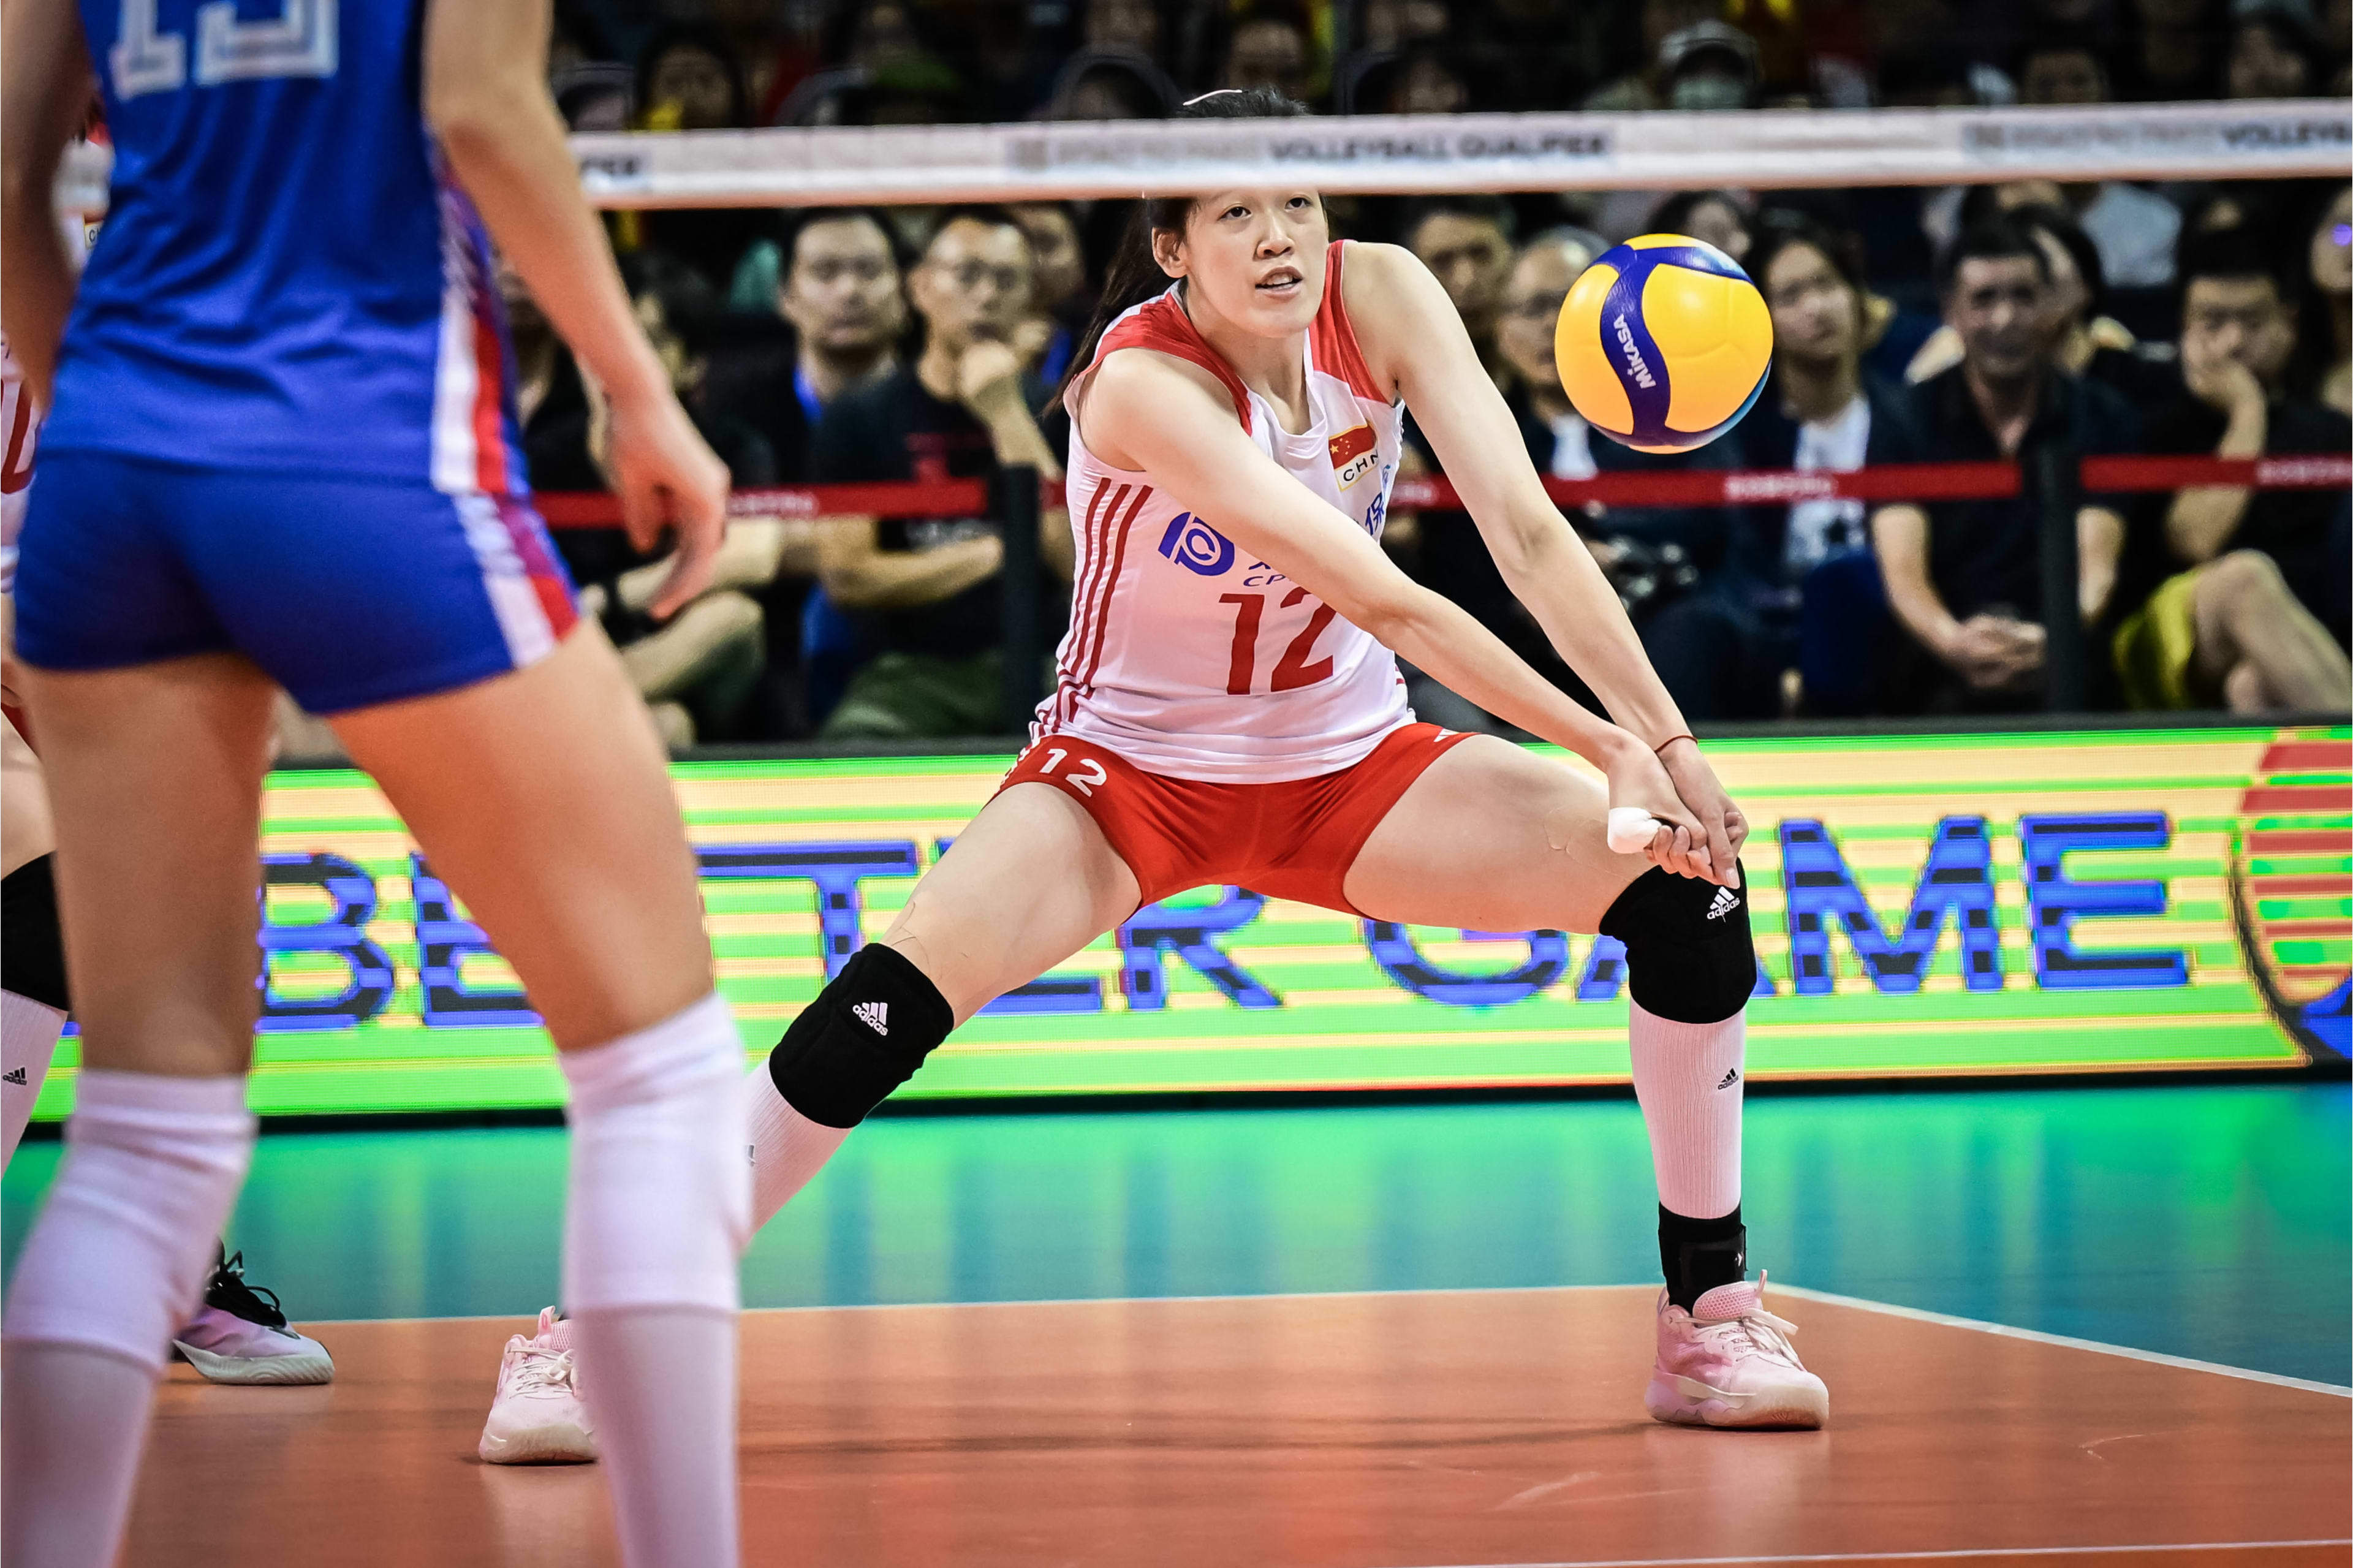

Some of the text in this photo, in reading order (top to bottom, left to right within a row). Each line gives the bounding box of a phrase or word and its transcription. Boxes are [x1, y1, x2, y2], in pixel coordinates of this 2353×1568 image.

[1343, 449, 1379, 482] CHN
[1218, 586, 1338, 695] 12
[1039, 748, 1107, 798] 12
[1707, 897, 1740, 920] adidas
[852, 1004, 889, 1036] adidas
